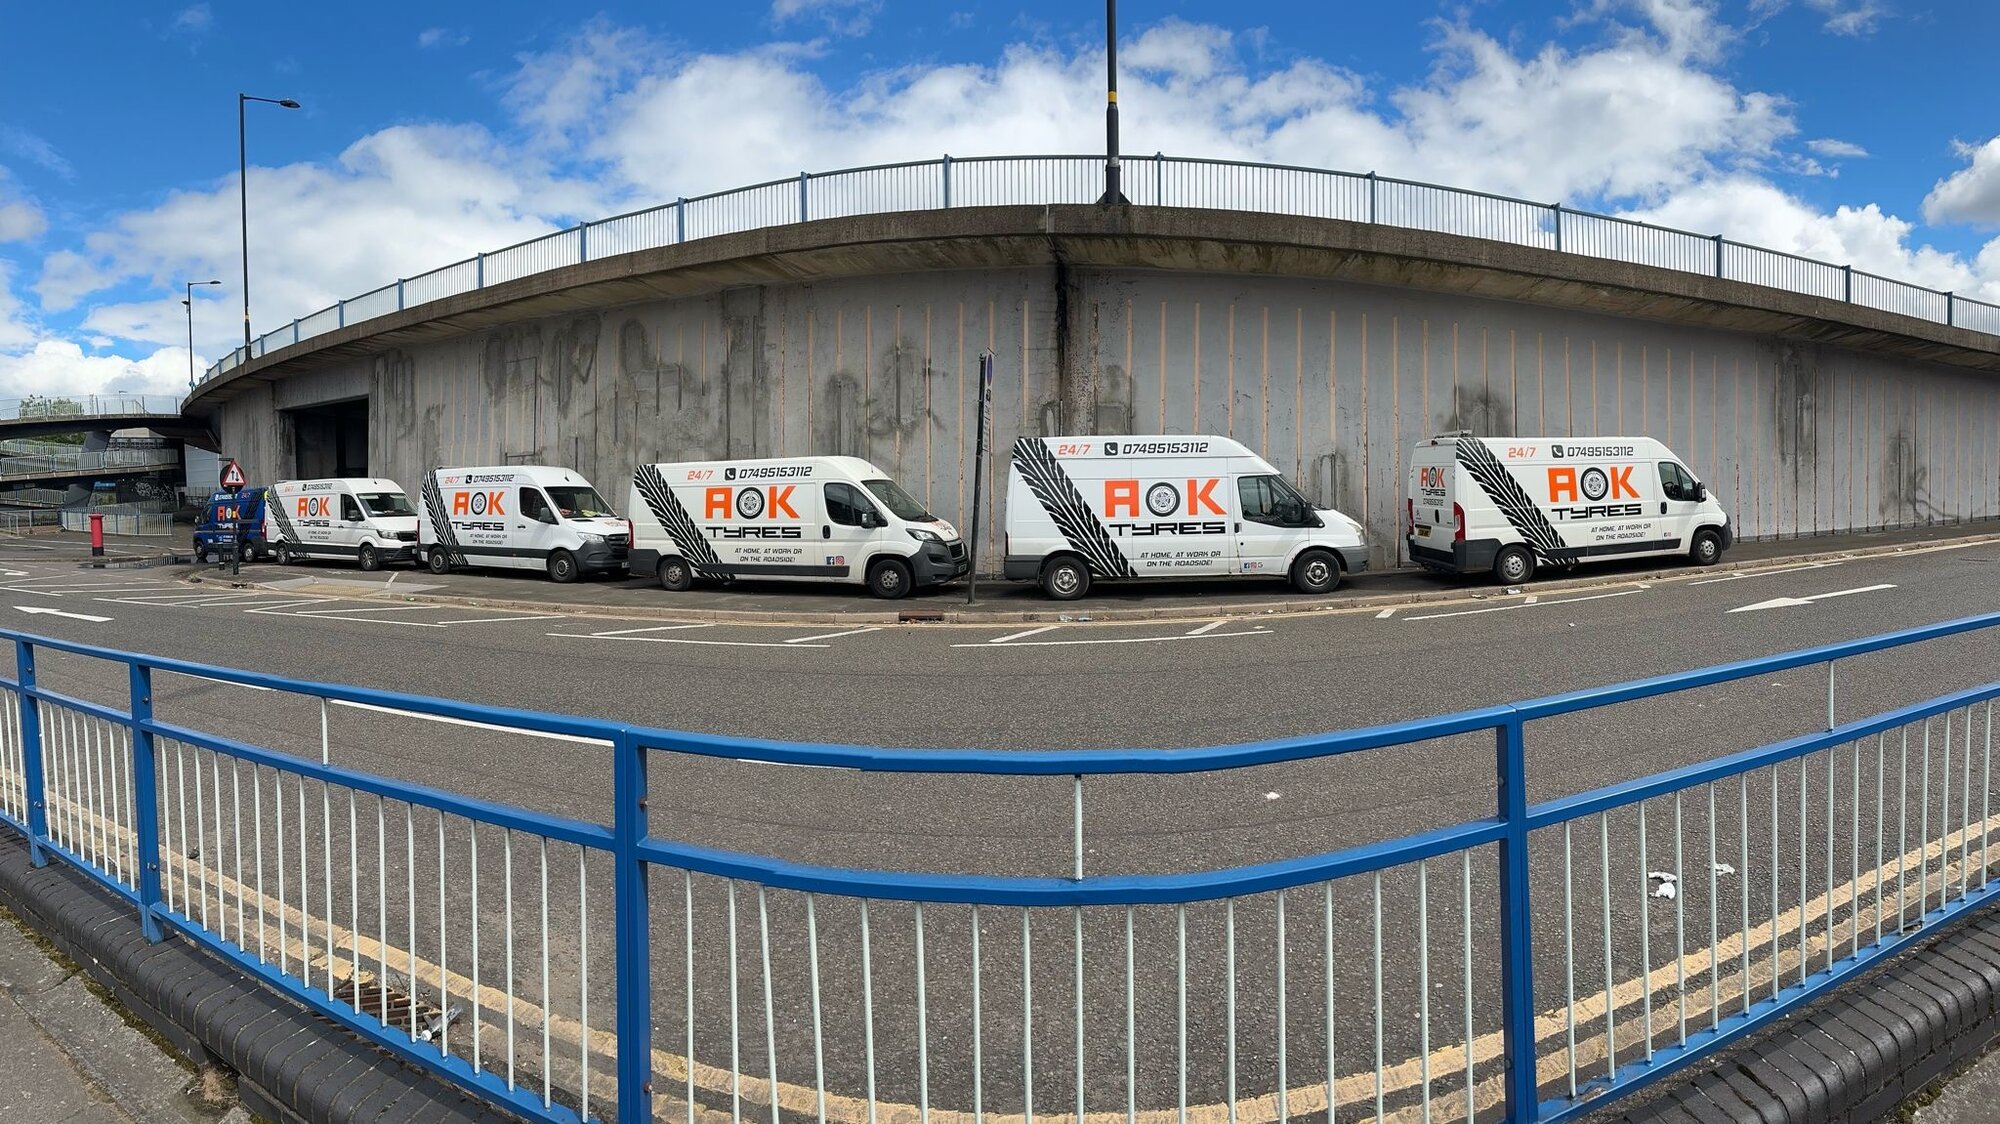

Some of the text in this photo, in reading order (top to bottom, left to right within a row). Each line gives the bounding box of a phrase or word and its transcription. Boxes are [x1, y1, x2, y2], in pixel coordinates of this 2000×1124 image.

[1058, 444, 1091, 455] 24/7
[1123, 442, 1209, 454] 07495153112
[1508, 447, 1536, 458] 24/7
[1567, 446, 1634, 457] 07495153112
[687, 470, 713, 480] 24/7
[739, 466, 813, 479] 07495153112
[1421, 488, 1446, 497] TYRES
[1551, 503, 1642, 520] TYRES
[297, 519, 330, 527] TYRES
[452, 521, 505, 531] TYRES
[705, 526, 802, 539] TYRES
[1108, 521, 1226, 537] TYRES
